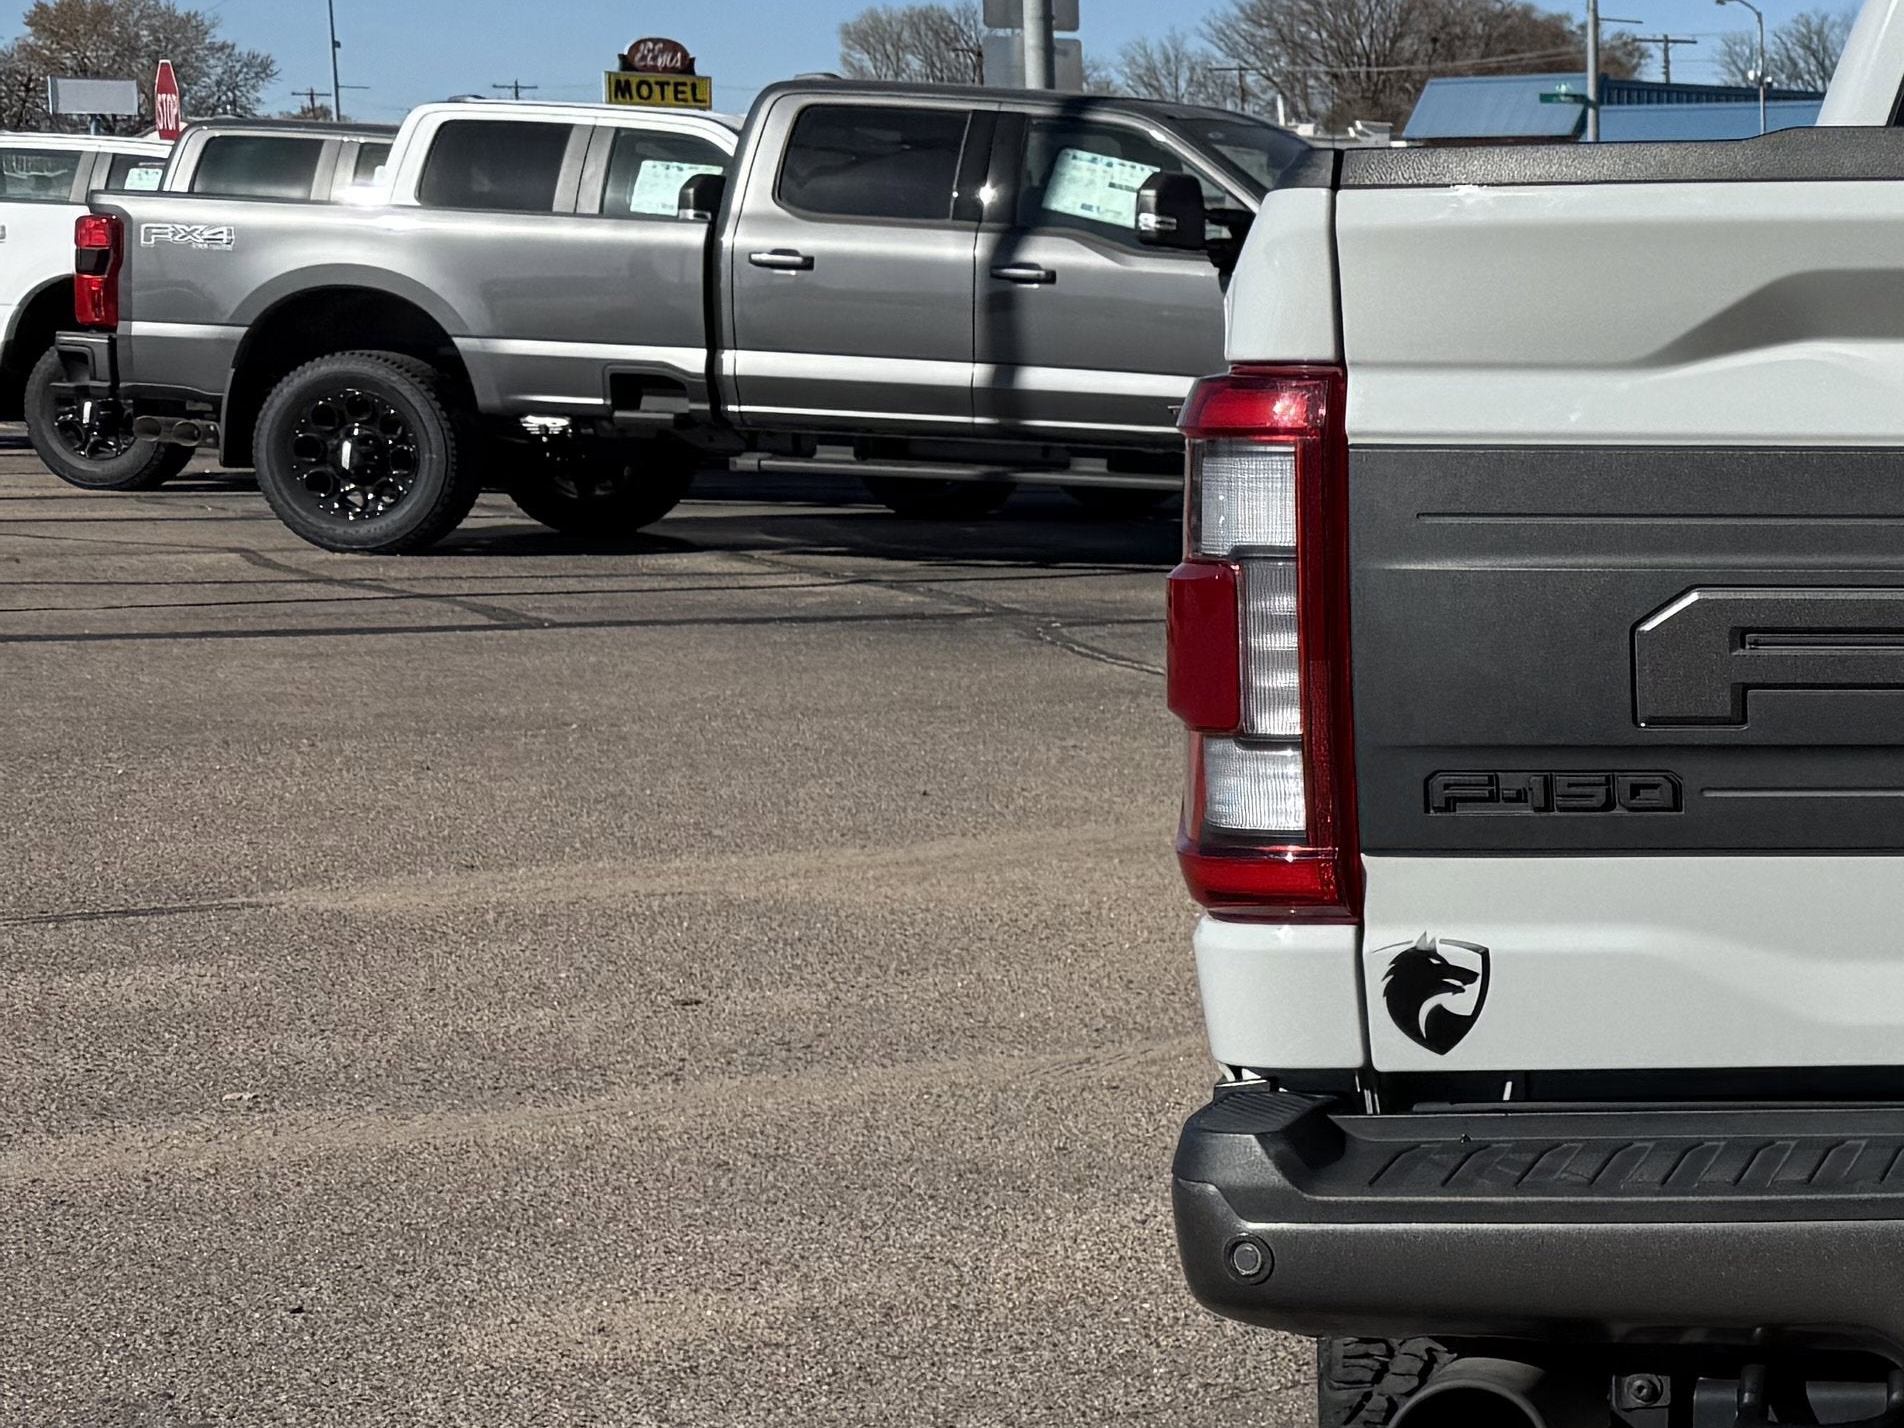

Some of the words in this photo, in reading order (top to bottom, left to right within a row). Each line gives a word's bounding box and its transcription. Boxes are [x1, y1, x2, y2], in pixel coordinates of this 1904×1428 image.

[614, 78, 708, 103] MOTEL
[156, 93, 179, 131] STOP
[141, 223, 234, 245] FX4
[1424, 769, 1684, 815] F-150
